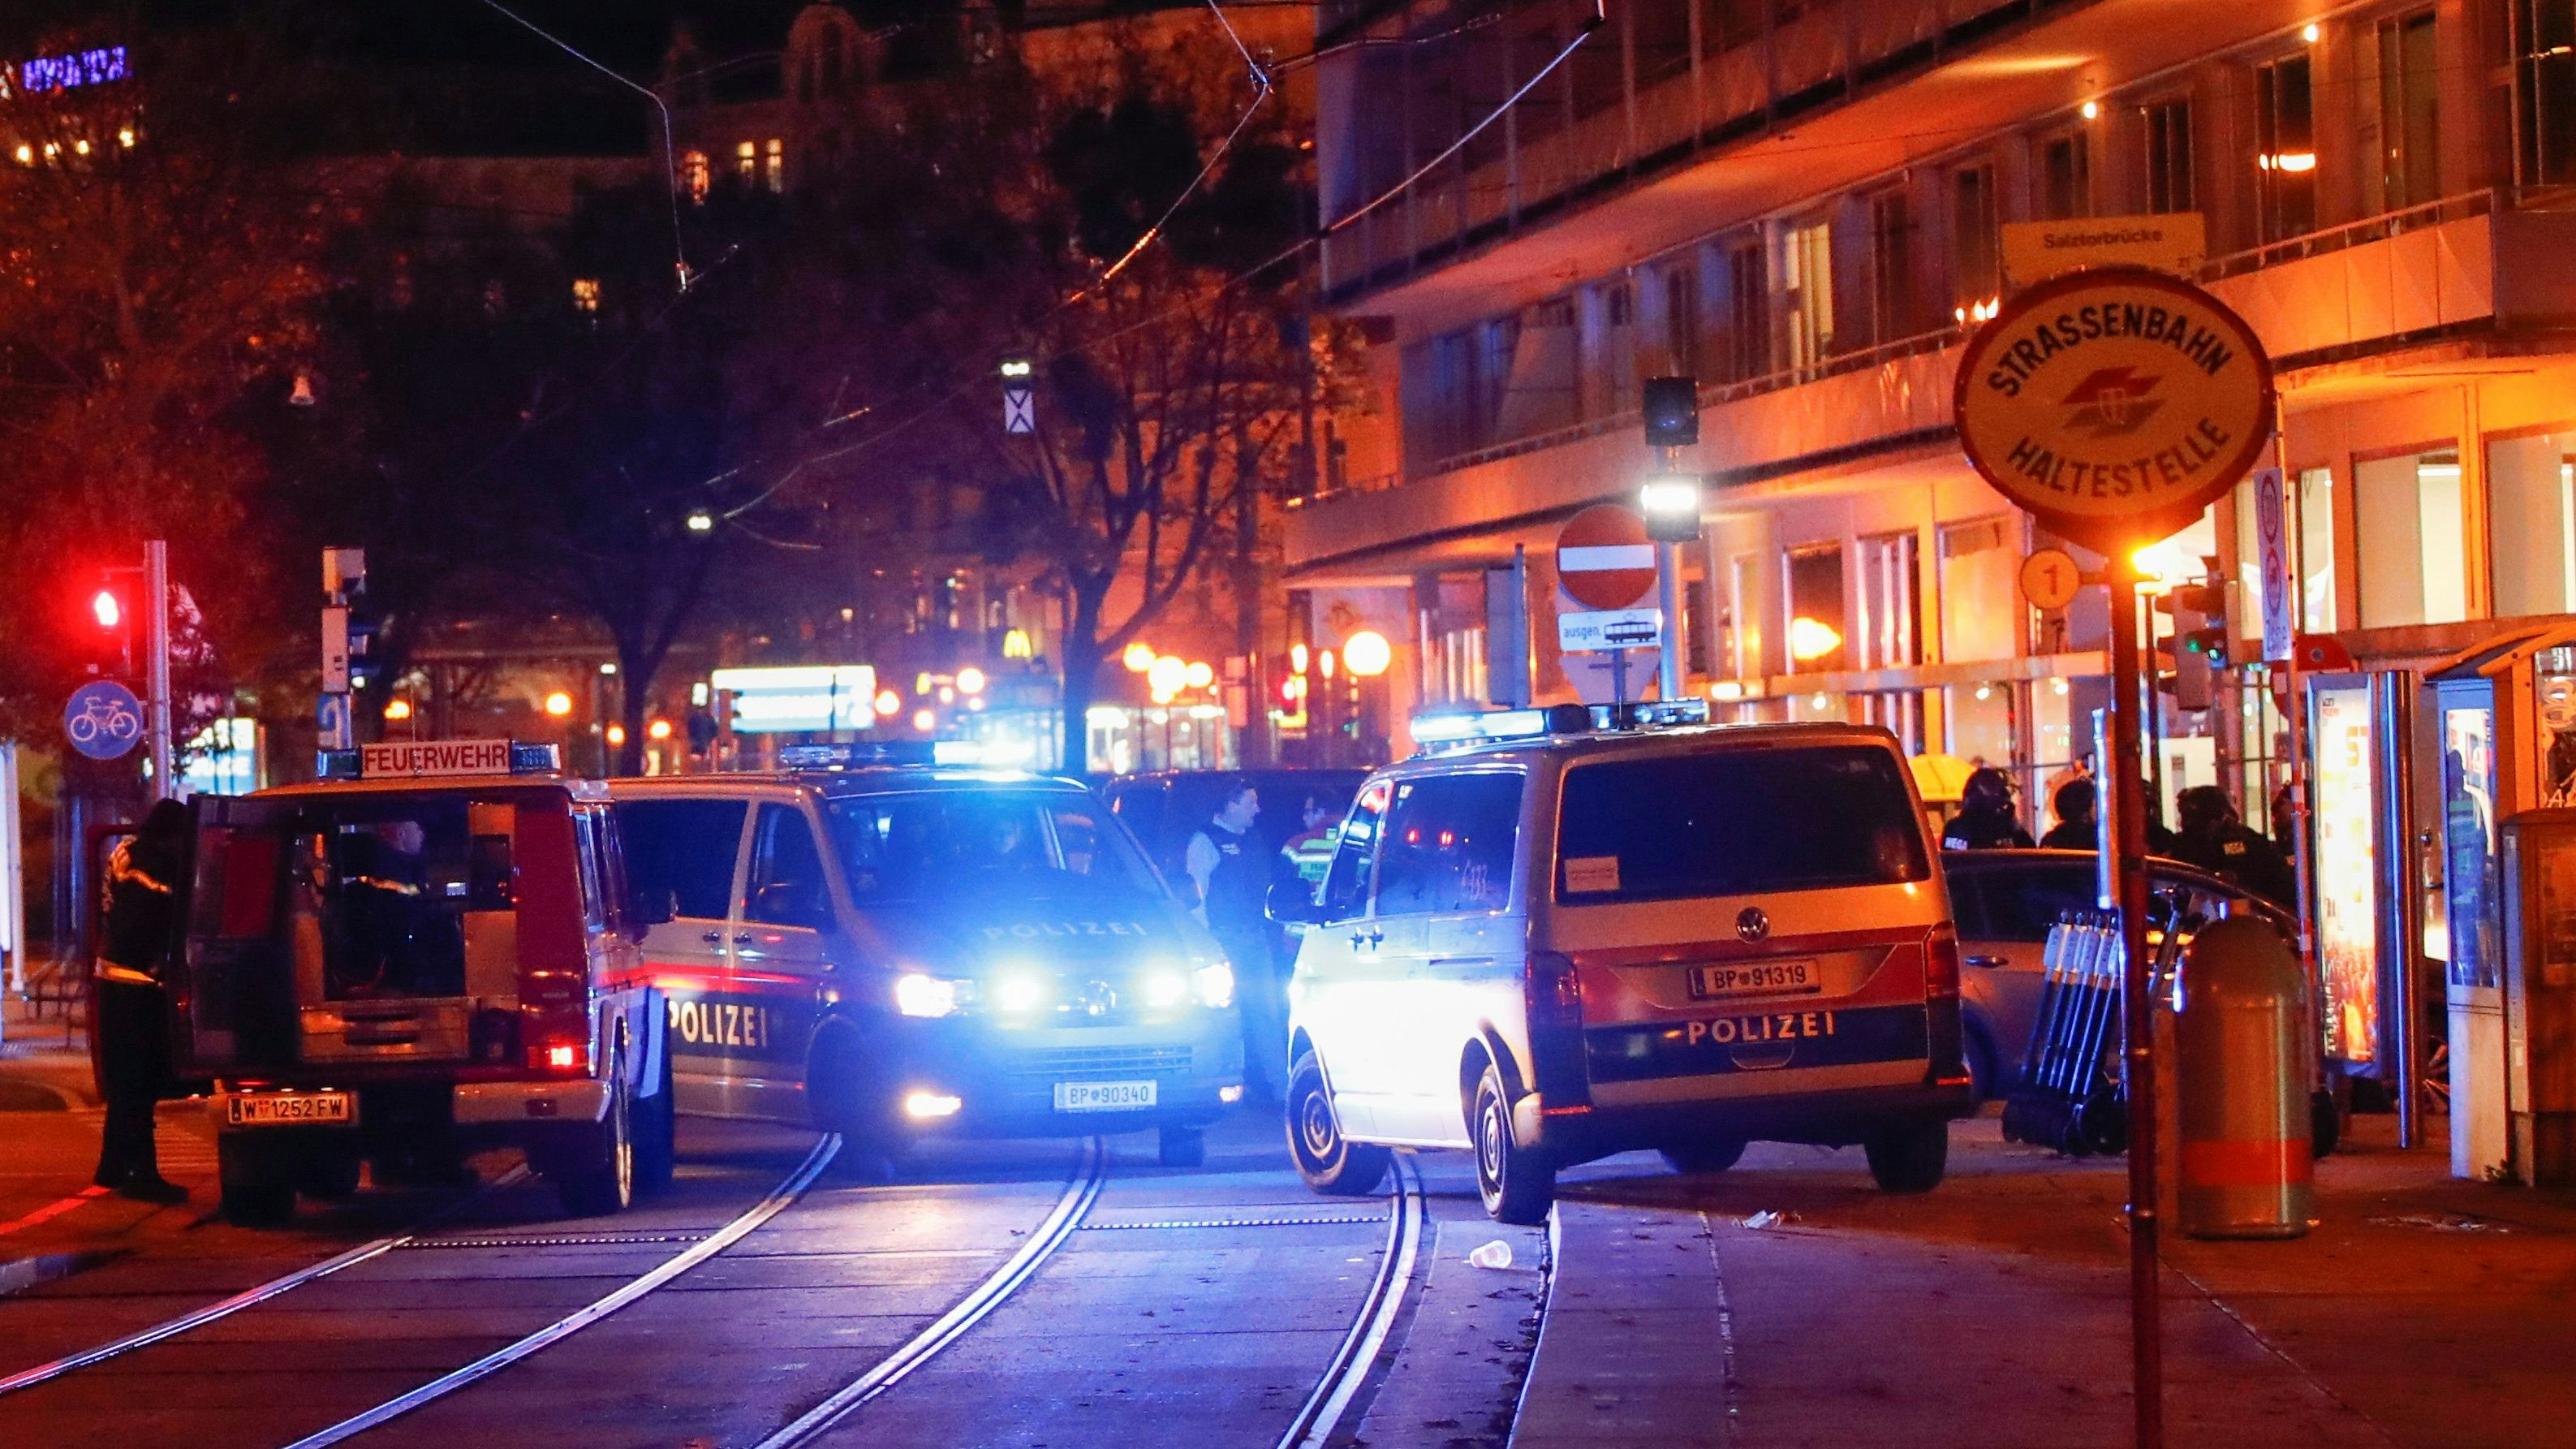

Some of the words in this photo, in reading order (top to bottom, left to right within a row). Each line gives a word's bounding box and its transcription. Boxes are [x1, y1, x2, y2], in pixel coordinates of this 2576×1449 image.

[2044, 229, 2164, 249] Salztorbrücke
[1988, 302, 2233, 398] STRASSENBAHN
[2006, 416, 2231, 498] HALTESTELLE
[2042, 563, 2058, 597] 1
[364, 744, 507, 772] FEUERWEHR
[983, 921, 1148, 939] POLIZEI
[1713, 970, 1737, 990] BP
[1753, 965, 1807, 986] 91319
[667, 1001, 768, 1047] POLIZEI
[1687, 1011, 1836, 1046] POLIZEI
[1070, 1088, 1089, 1105] BP
[1101, 1085, 1149, 1103] 90340
[243, 1101, 257, 1119] W
